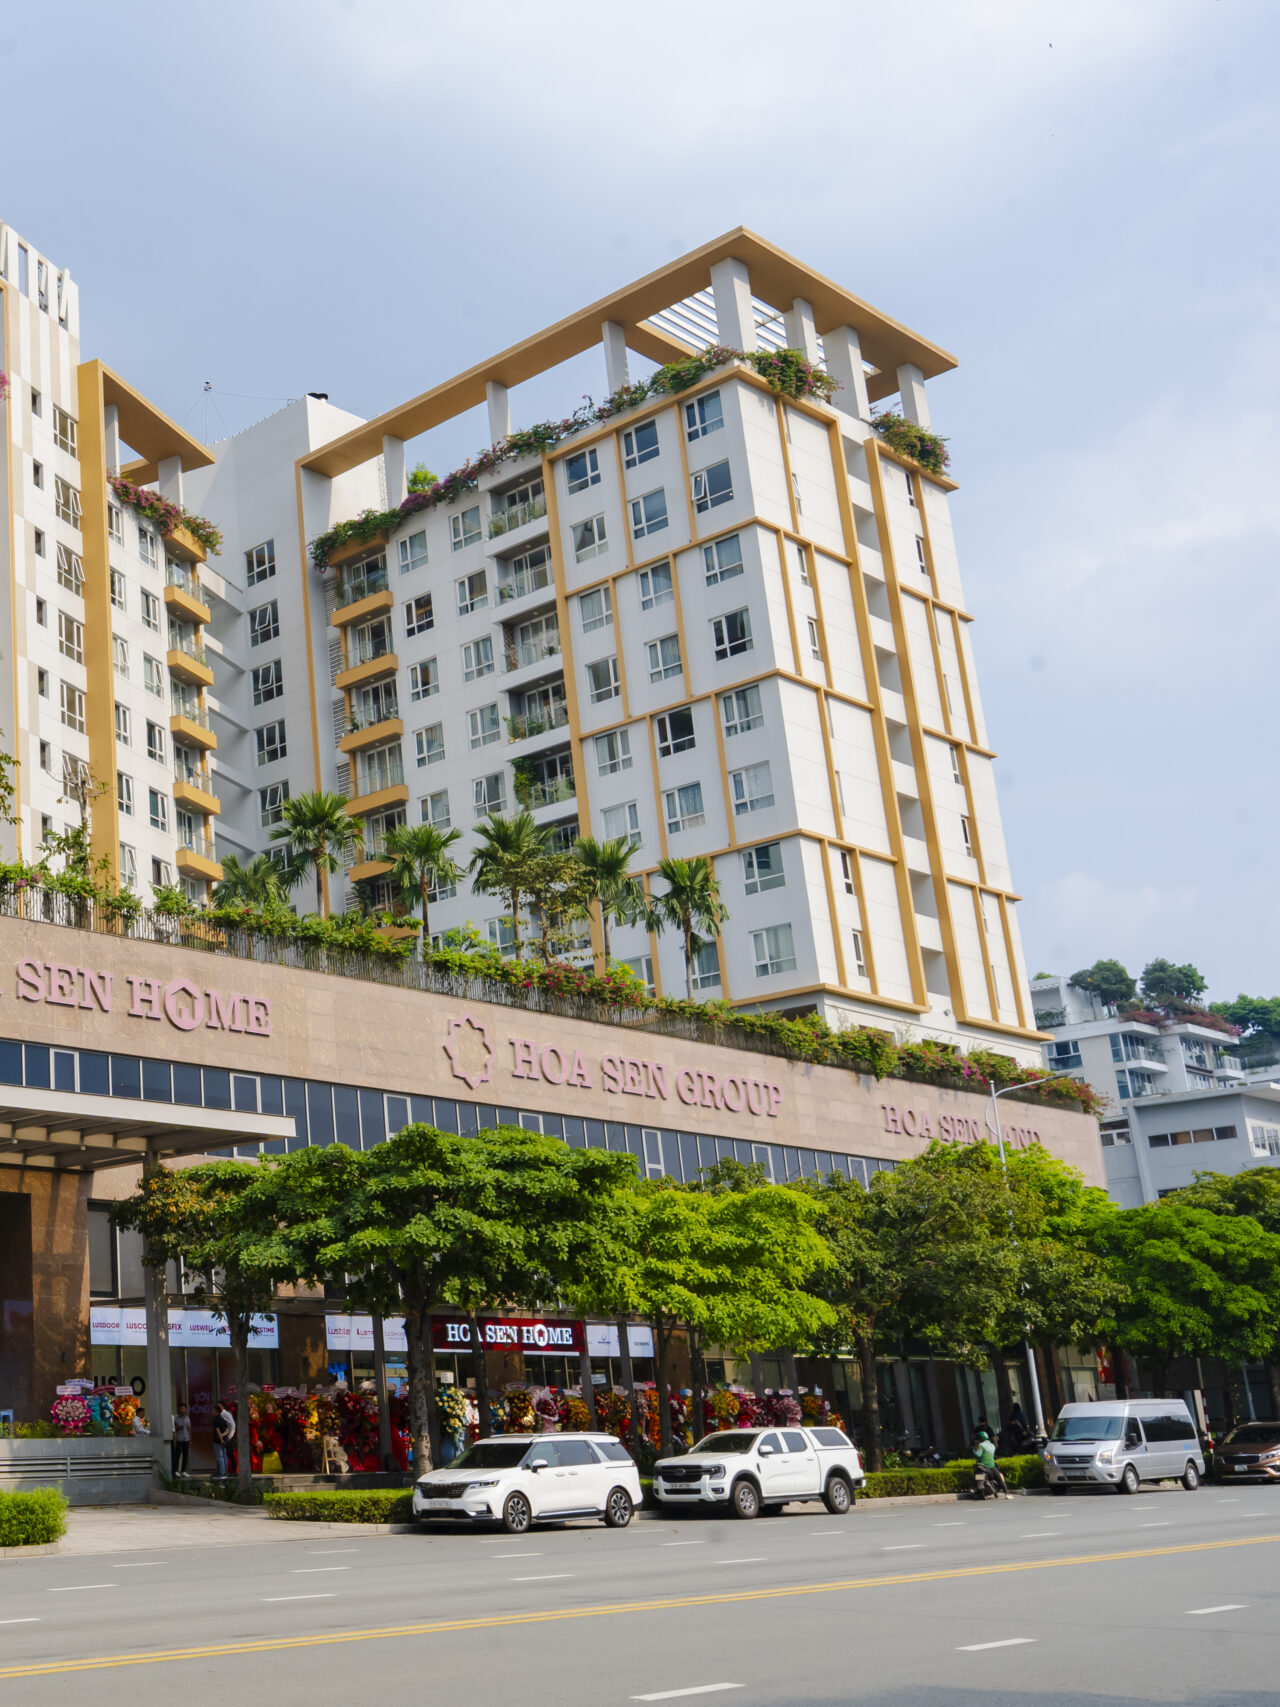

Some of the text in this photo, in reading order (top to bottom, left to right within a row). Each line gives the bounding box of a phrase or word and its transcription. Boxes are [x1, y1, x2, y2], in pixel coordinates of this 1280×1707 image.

[17, 957, 114, 1012] SEN
[127, 975, 273, 1036] HOME
[509, 1037, 785, 1117] HOA SEN GROUP
[881, 1103, 935, 1139] HOA
[938, 1113, 982, 1145] SEN
[485, 1324, 518, 1343] SEN
[521, 1324, 573, 1346] HOME
